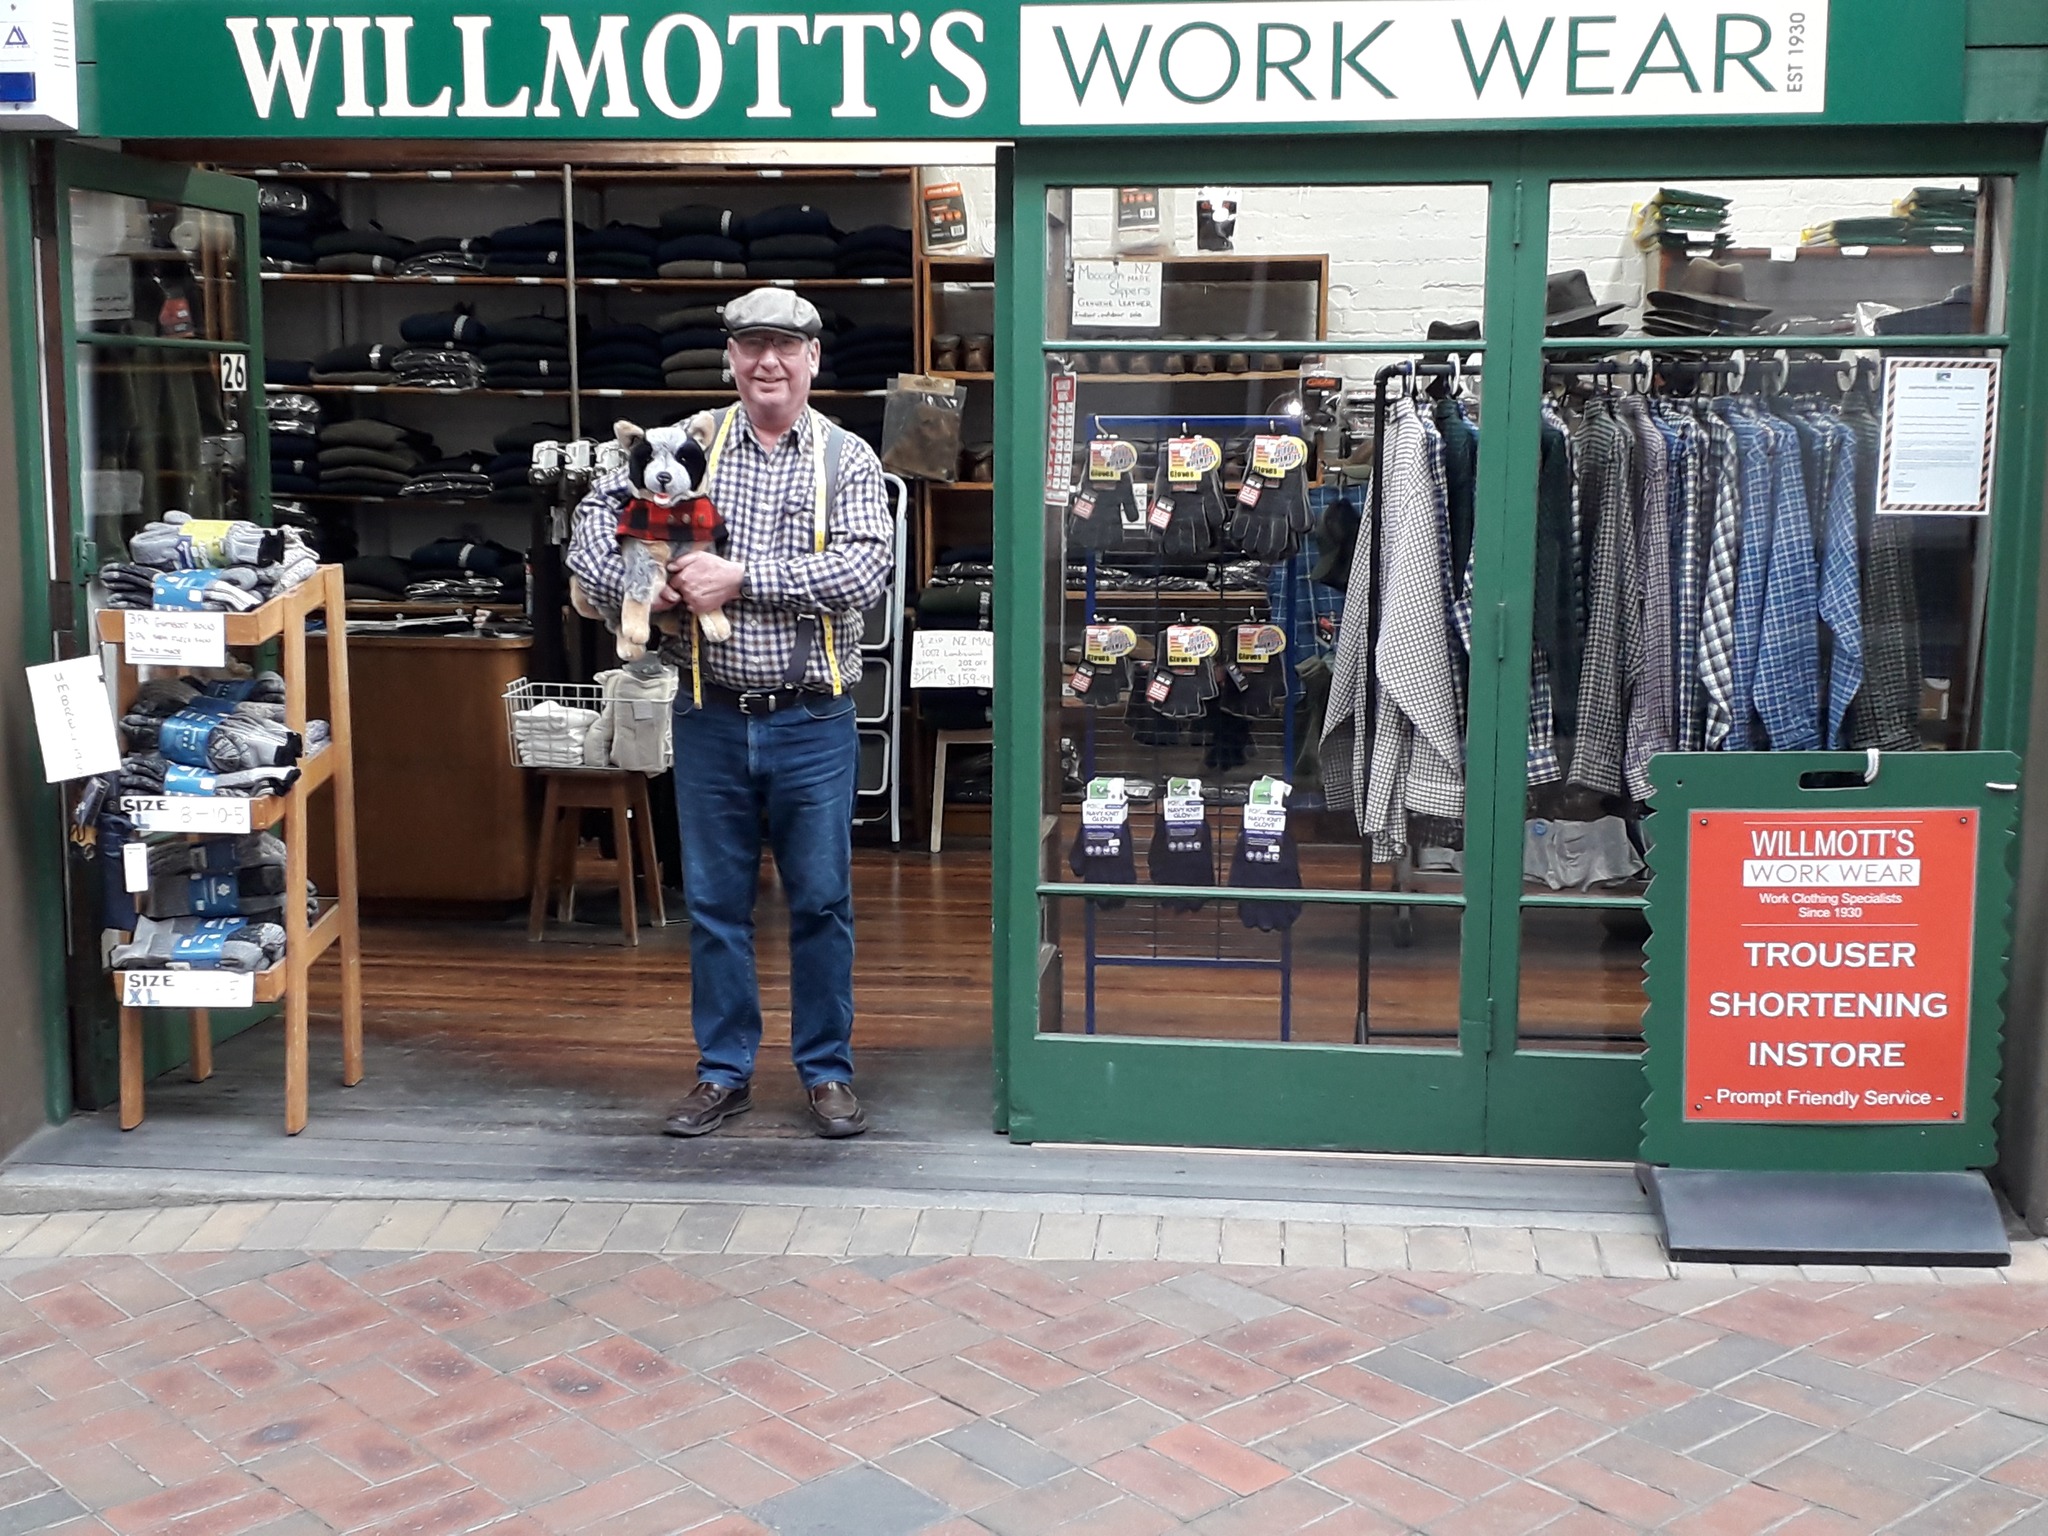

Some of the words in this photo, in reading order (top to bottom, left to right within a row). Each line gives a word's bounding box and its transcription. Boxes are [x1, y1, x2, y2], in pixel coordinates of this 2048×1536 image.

[1788, 12, 1806, 55] 1930
[225, 11, 988, 120] WILLMOTT'S
[1052, 19, 1399, 107] WORK
[1451, 12, 1778, 100] WEAR
[1786, 63, 1804, 92] EST
[223, 355, 245, 389] 26
[123, 798, 170, 812] SIZE
[1751, 829, 1915, 857] WILLMOTT'S
[1751, 864, 1830, 883] WORK
[1839, 863, 1913, 883] WEAR
[1759, 892, 1789, 904] Work
[1791, 892, 1839, 906] Clothing
[1841, 892, 1903, 906] Specialists
[1798, 907, 1831, 918] Since
[1834, 907, 1863, 918] 1930
[1743, 942, 1916, 968] TROUSER
[128, 973, 175, 988] SIZE
[128, 988, 160, 1005] XL
[1708, 991, 1948, 1019] SHORTENING
[1748, 1042, 1906, 1068] INSTORE
[1716, 1089, 1783, 1107] Prompt
[1786, 1089, 1859, 1108] Friendly
[1864, 1090, 1932, 1105] Service
